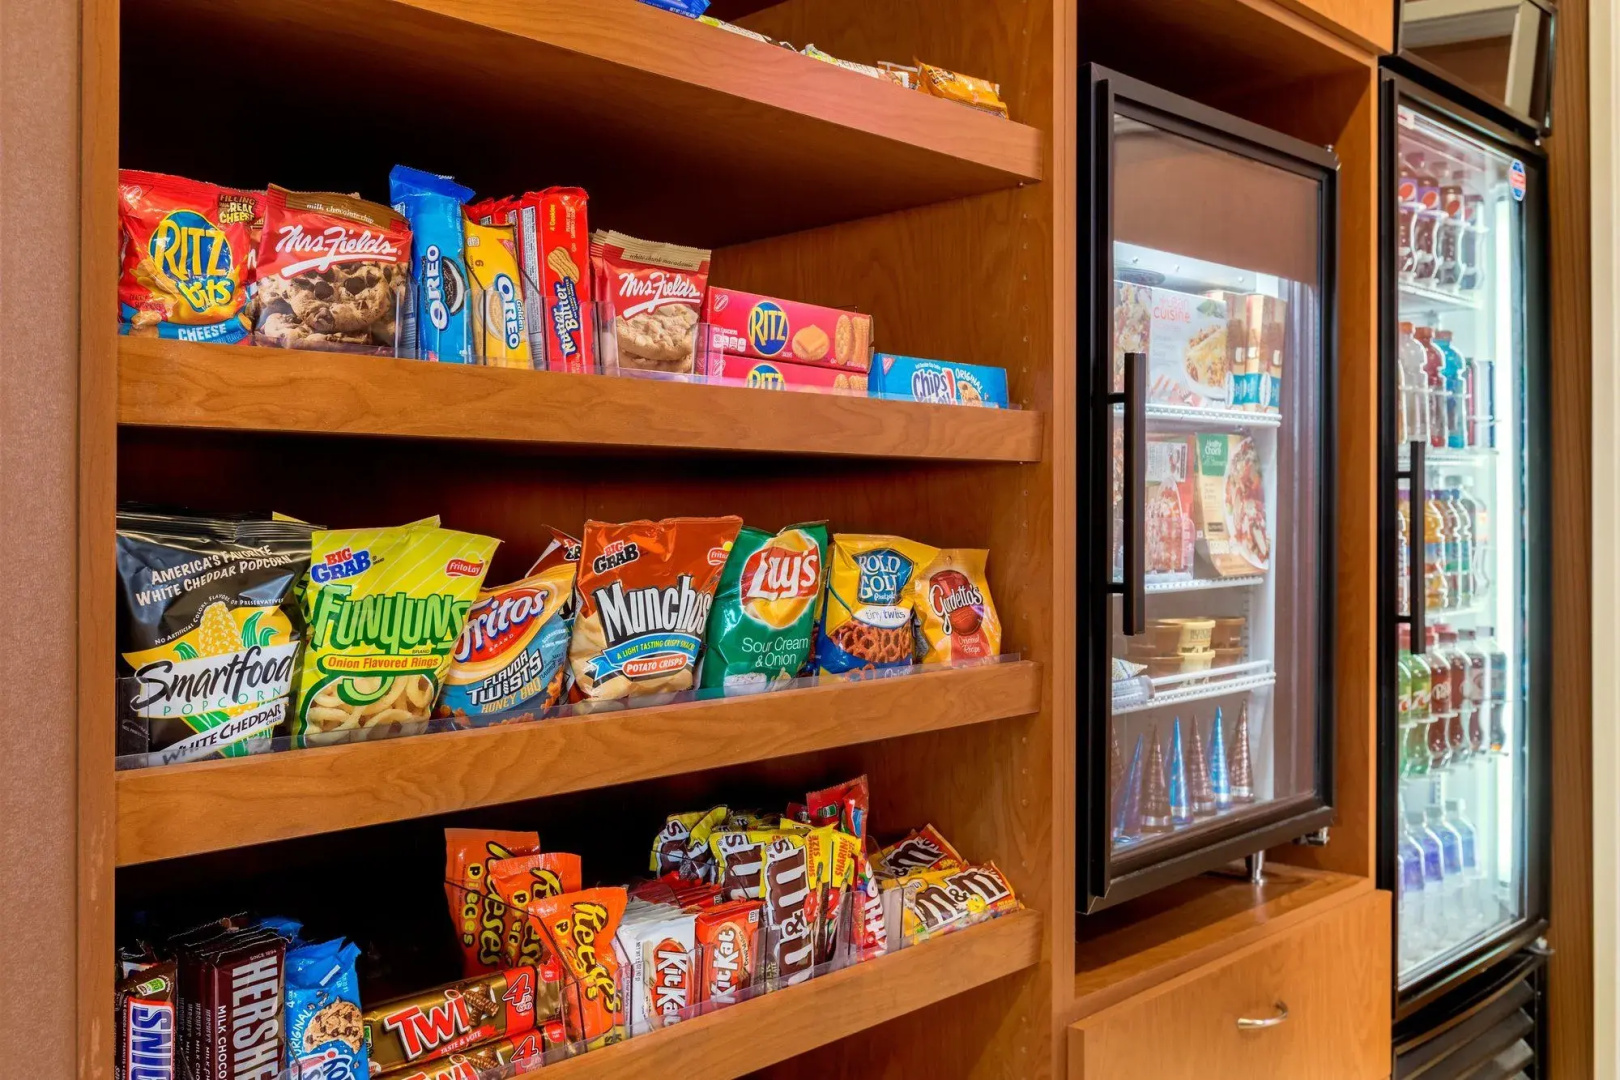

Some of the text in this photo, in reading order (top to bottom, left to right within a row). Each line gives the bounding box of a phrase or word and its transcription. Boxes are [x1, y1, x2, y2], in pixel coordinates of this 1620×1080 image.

[154, 219, 226, 281] RITZ
[426, 245, 448, 330] OREO
[497, 274, 520, 349] OREO
[516, 300, 525, 331] Golden
[556, 284, 579, 331] Butter
[178, 323, 227, 342] CHEESE
[751, 306, 786, 346] RITZ
[913, 369, 947, 401] Chips
[955, 368, 984, 394] ORIGINAL
[151, 544, 273, 585] AMERICA'S FAVORITE
[325, 547, 353, 566] BIG
[593, 543, 639, 574] GRAB
[604, 541, 624, 557] BIG
[858, 554, 901, 575] ROLD
[311, 550, 371, 584] GRAB
[746, 550, 818, 601] Lay's
[136, 583, 181, 607] WHITE
[183, 565, 237, 592] CHEDDAR
[239, 597, 284, 605] PRESERVATIVES
[452, 589, 549, 662] oritos
[616, 652, 623, 660] A
[622, 646, 639, 658] LIGHT
[641, 640, 664, 651] TASTING
[741, 636, 809, 653] Sour Cream
[755, 652, 797, 668] & Onion
[130, 642, 299, 711] Smartfood
[328, 655, 439, 669] Onion Flavored Rings
[466, 649, 544, 706] TWISTS
[484, 650, 529, 690] FLAVOR
[627, 657, 684, 672] POTATO CRISPS
[163, 685, 282, 716] POPCORN
[481, 678, 543, 714] HONEY BBQ
[162, 731, 218, 765] WHITE
[219, 703, 282, 740] CHEDDAR
[812, 835, 820, 857] SIZE
[502, 973, 531, 1008] 4
[217, 1005, 227, 1034] MILK
[289, 1009, 313, 1058] ORIGINAL
[465, 1031, 481, 1045] VOTE
